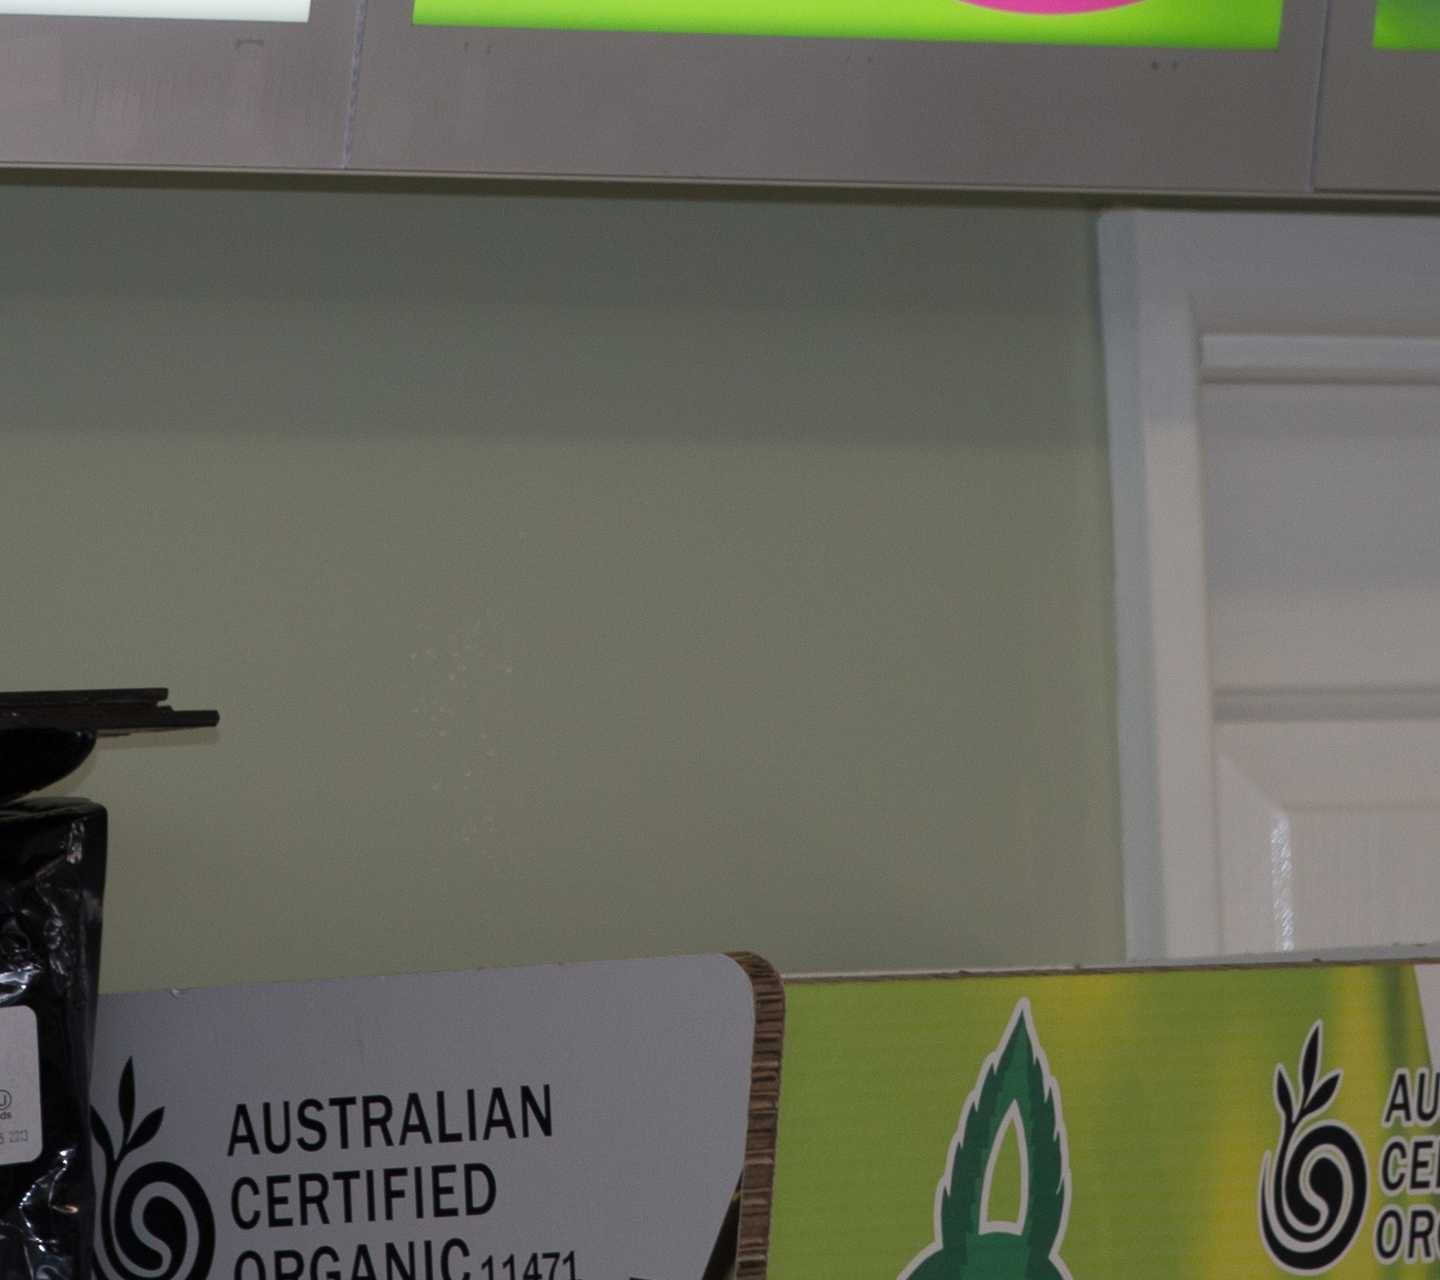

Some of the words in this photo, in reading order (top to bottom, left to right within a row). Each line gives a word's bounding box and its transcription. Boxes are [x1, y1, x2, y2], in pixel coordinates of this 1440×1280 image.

[227, 1083, 555, 1158] AUSTRALIAN
[230, 1162, 498, 1231] CERTIFIED
[234, 1238, 472, 1280] ORGANIC
